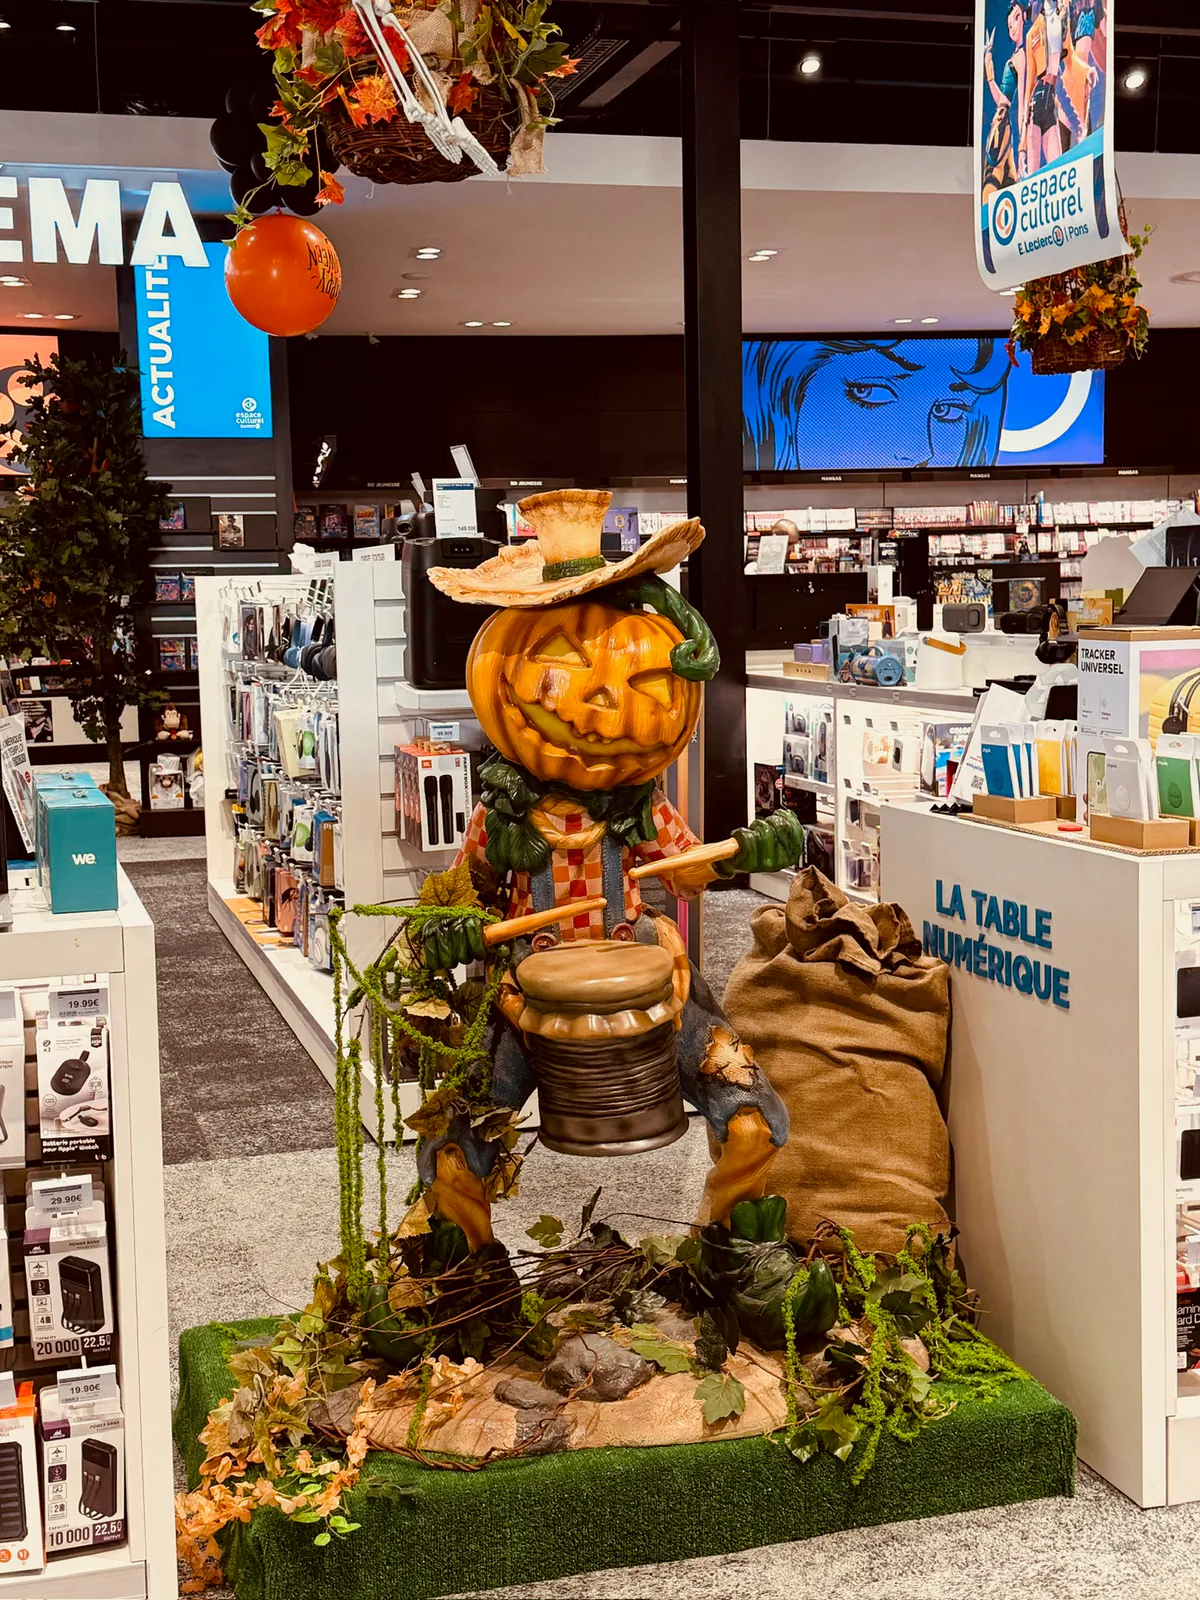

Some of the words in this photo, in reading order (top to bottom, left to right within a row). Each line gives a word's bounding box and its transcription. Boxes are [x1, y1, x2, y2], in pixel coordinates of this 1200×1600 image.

[1021, 167, 1077, 206] espace
[1020, 186, 1083, 232] culturel
[1068, 223, 1089, 239] Pons
[1081, 648, 1116, 661] TRACKER
[1081, 661, 1124, 675] UNIVERSEL
[936, 879, 966, 921] LA
[971, 889, 1052, 949] TABLE
[923, 920, 1070, 1009] NUMÉRIQUE
[68, 998, 99, 1009] 19.99€
[42, 1139, 68, 1147] Batterie
[69, 1137, 96, 1148] portable
[79, 1143, 100, 1151] Watch
[50, 1193, 82, 1205] 29.90€
[1177, 1303, 1200, 1316] amin
[40, 1316, 45, 1324] 4
[1177, 1314, 1193, 1326] ard
[36, 1341, 53, 1355] 20
[55, 1338, 80, 1353] 000
[70, 1383, 101, 1394] 19.90€
[54, 1504, 59, 1513] 2
[48, 1531, 63, 1547] 10
[66, 1526, 90, 1543] 000
